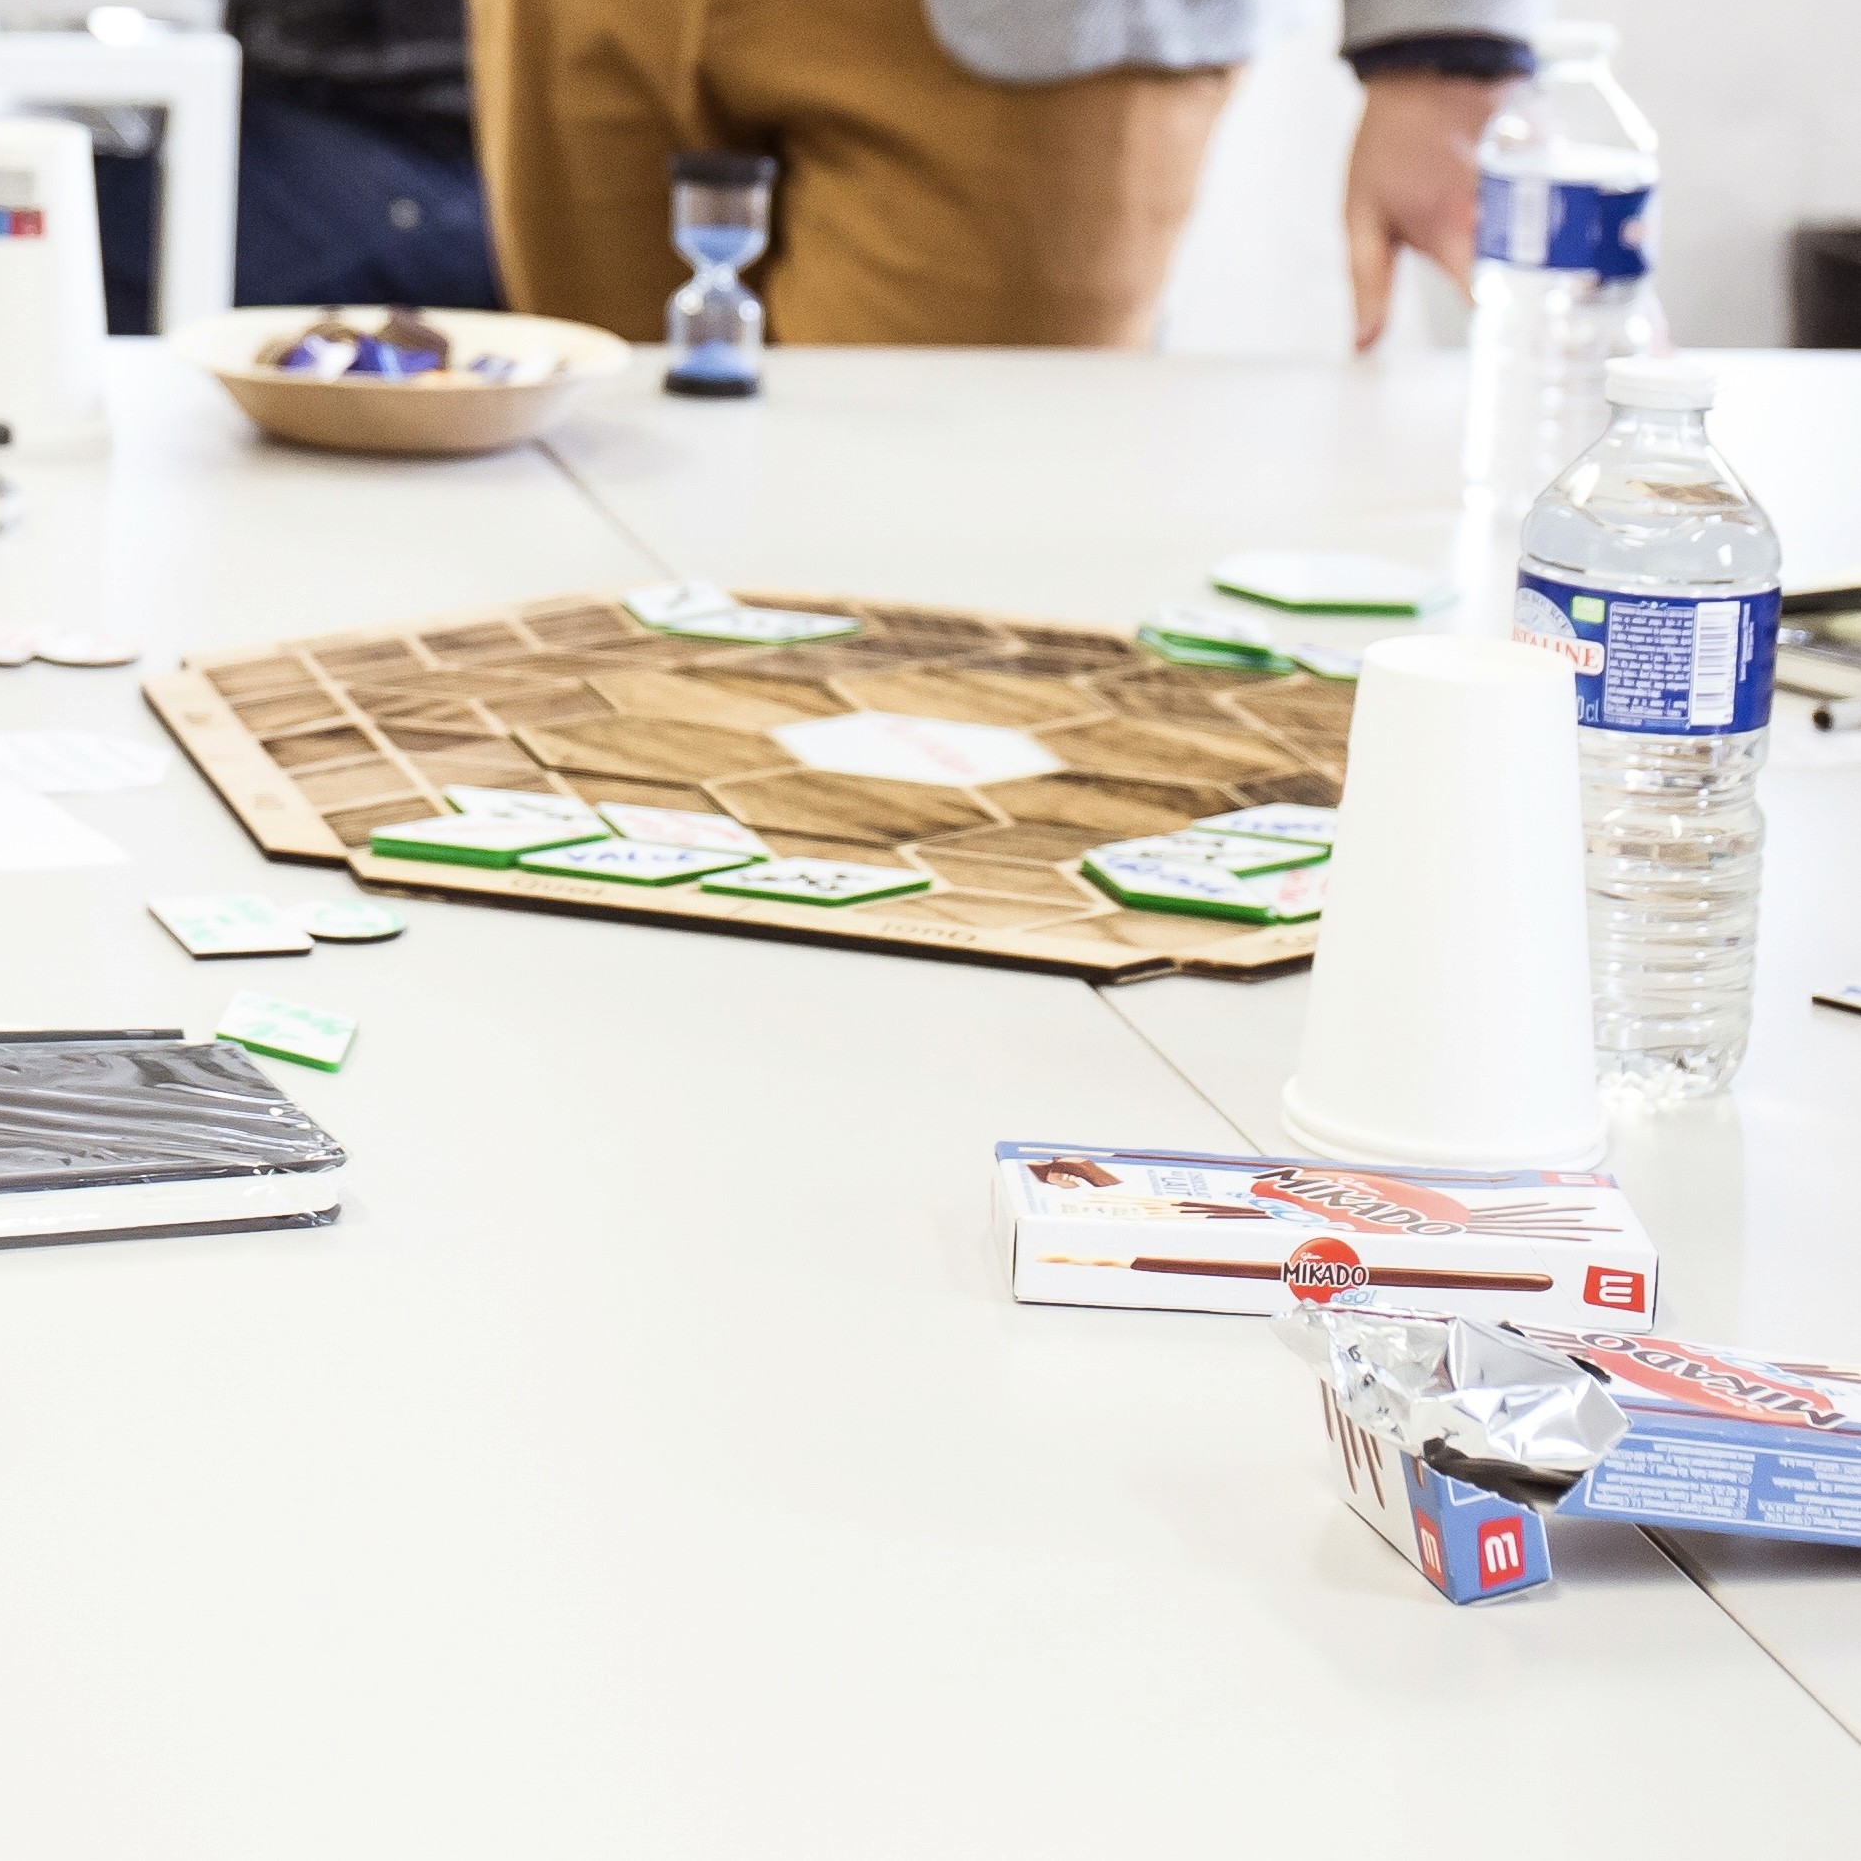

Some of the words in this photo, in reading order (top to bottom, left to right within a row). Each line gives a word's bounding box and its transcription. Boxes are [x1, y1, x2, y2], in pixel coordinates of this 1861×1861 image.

[1252, 1167, 1462, 1236] MIKADO
[1282, 1261, 1368, 1287] MIKADO
[1581, 1333, 1847, 1426] MIKADO
[1484, 1530, 1519, 1573] LU
